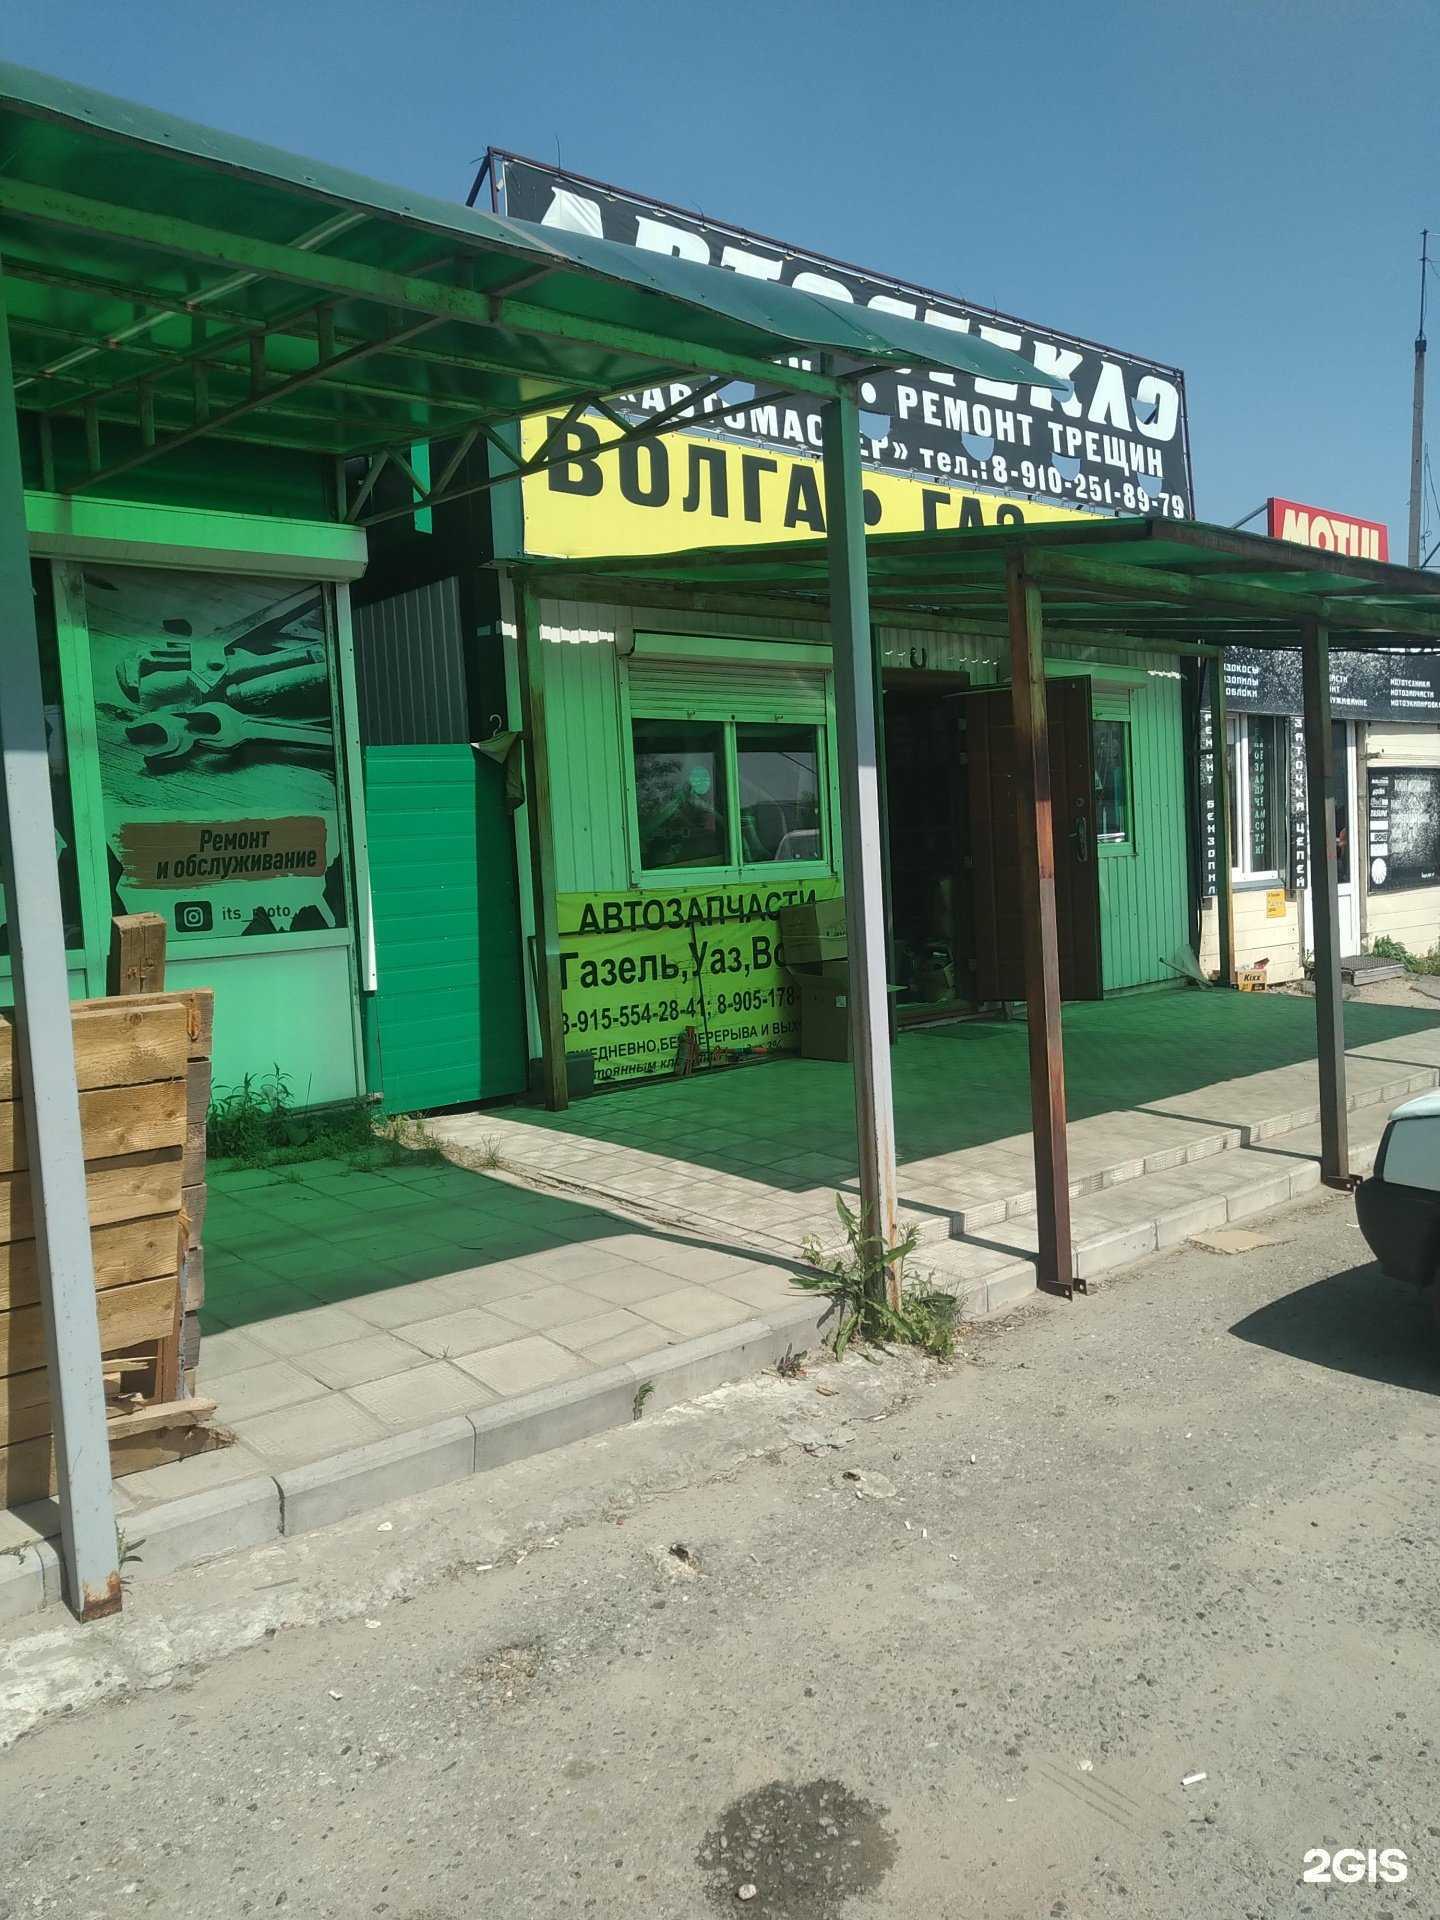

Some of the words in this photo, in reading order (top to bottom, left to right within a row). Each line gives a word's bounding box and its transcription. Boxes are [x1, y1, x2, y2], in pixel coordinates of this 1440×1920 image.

[897, 385, 1033, 447] РЕМОНТ
[1048, 421, 1164, 479] ТРЕЩИН
[546, 416, 826, 533] ВОЛГА
[1224, 663, 1259, 674] ЗОКОСЫ
[1224, 675, 1259, 686] ЗОПИЛЫ
[1225, 687, 1258, 698] ОБЛОКИ
[1294, 717, 1305, 811] ЗАТОЧКА
[200, 829, 270, 852] Ремонт
[156, 861, 169, 880] и
[174, 850, 318, 880] обслуживание
[761, 1026, 770, 1037] И
